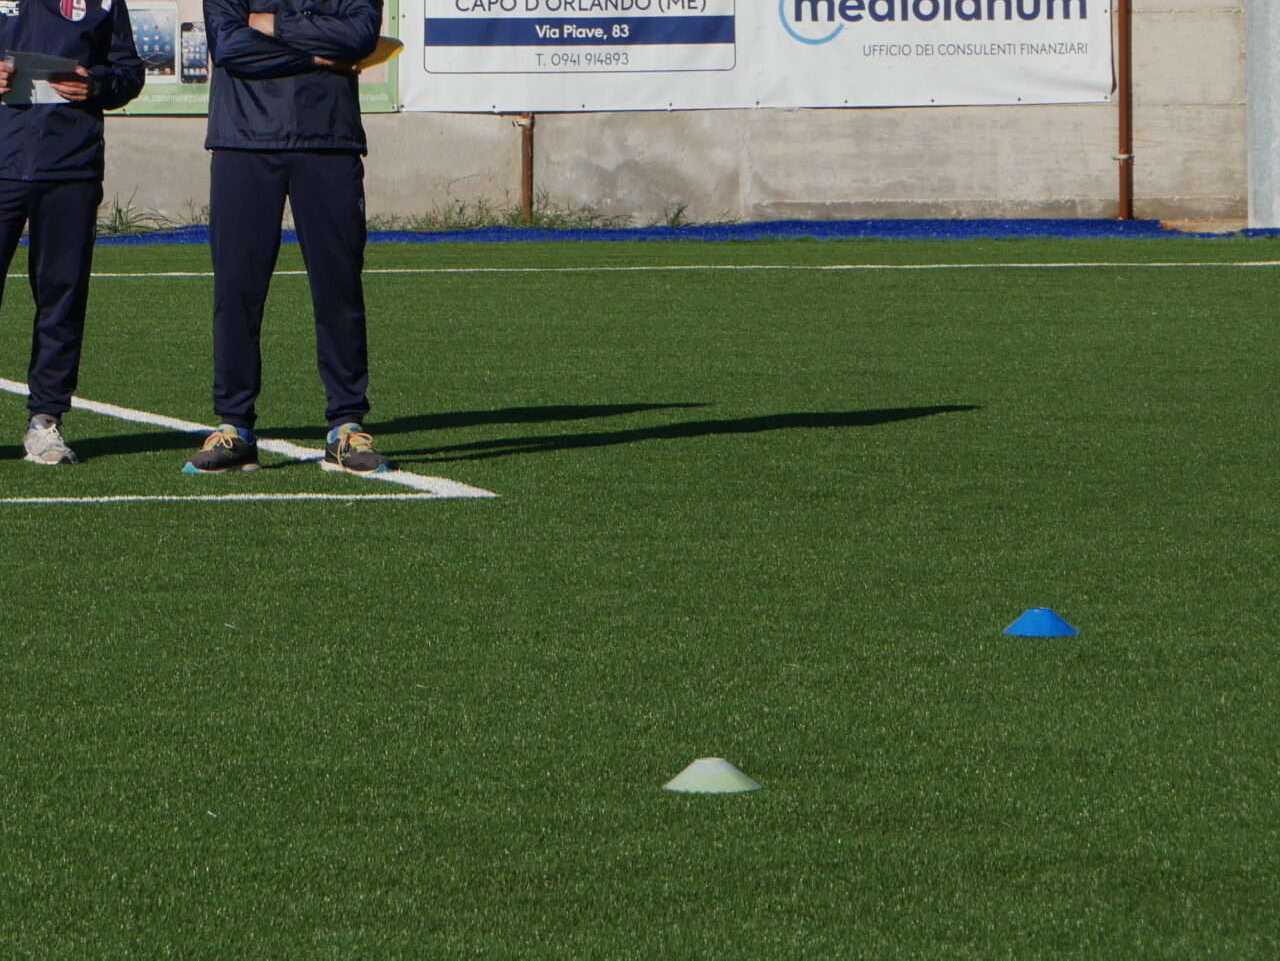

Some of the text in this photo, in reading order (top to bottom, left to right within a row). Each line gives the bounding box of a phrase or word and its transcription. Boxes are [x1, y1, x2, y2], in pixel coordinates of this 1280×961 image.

[535, 24, 630, 40] Via Piave, 83
[862, 42, 1088, 57] UFFICIO DEI CONSULENTI FINANZIARI
[535, 52, 630, 67] T. 0941 914893
